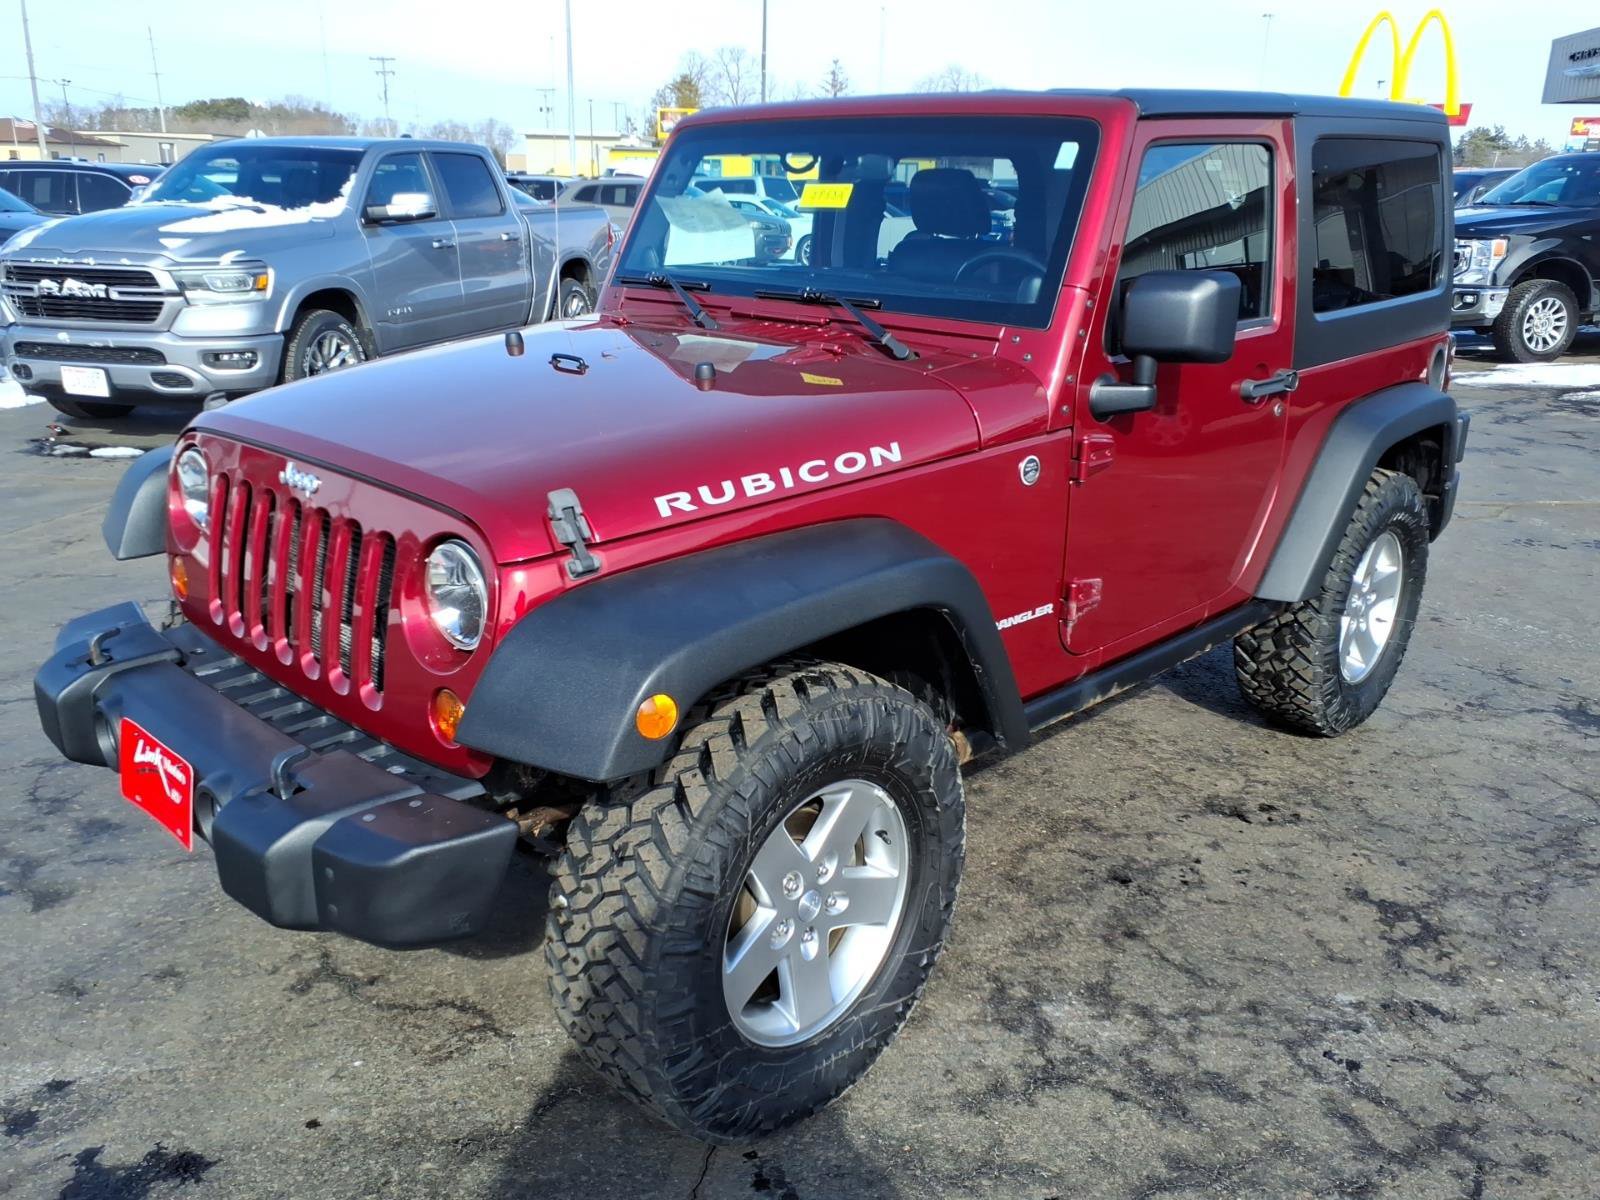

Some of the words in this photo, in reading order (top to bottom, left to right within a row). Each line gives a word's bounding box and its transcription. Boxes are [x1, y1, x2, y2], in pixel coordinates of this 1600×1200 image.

[38, 278, 107, 297] RAM
[279, 462, 322, 498] Jeep
[653, 441, 902, 518] RUBICON
